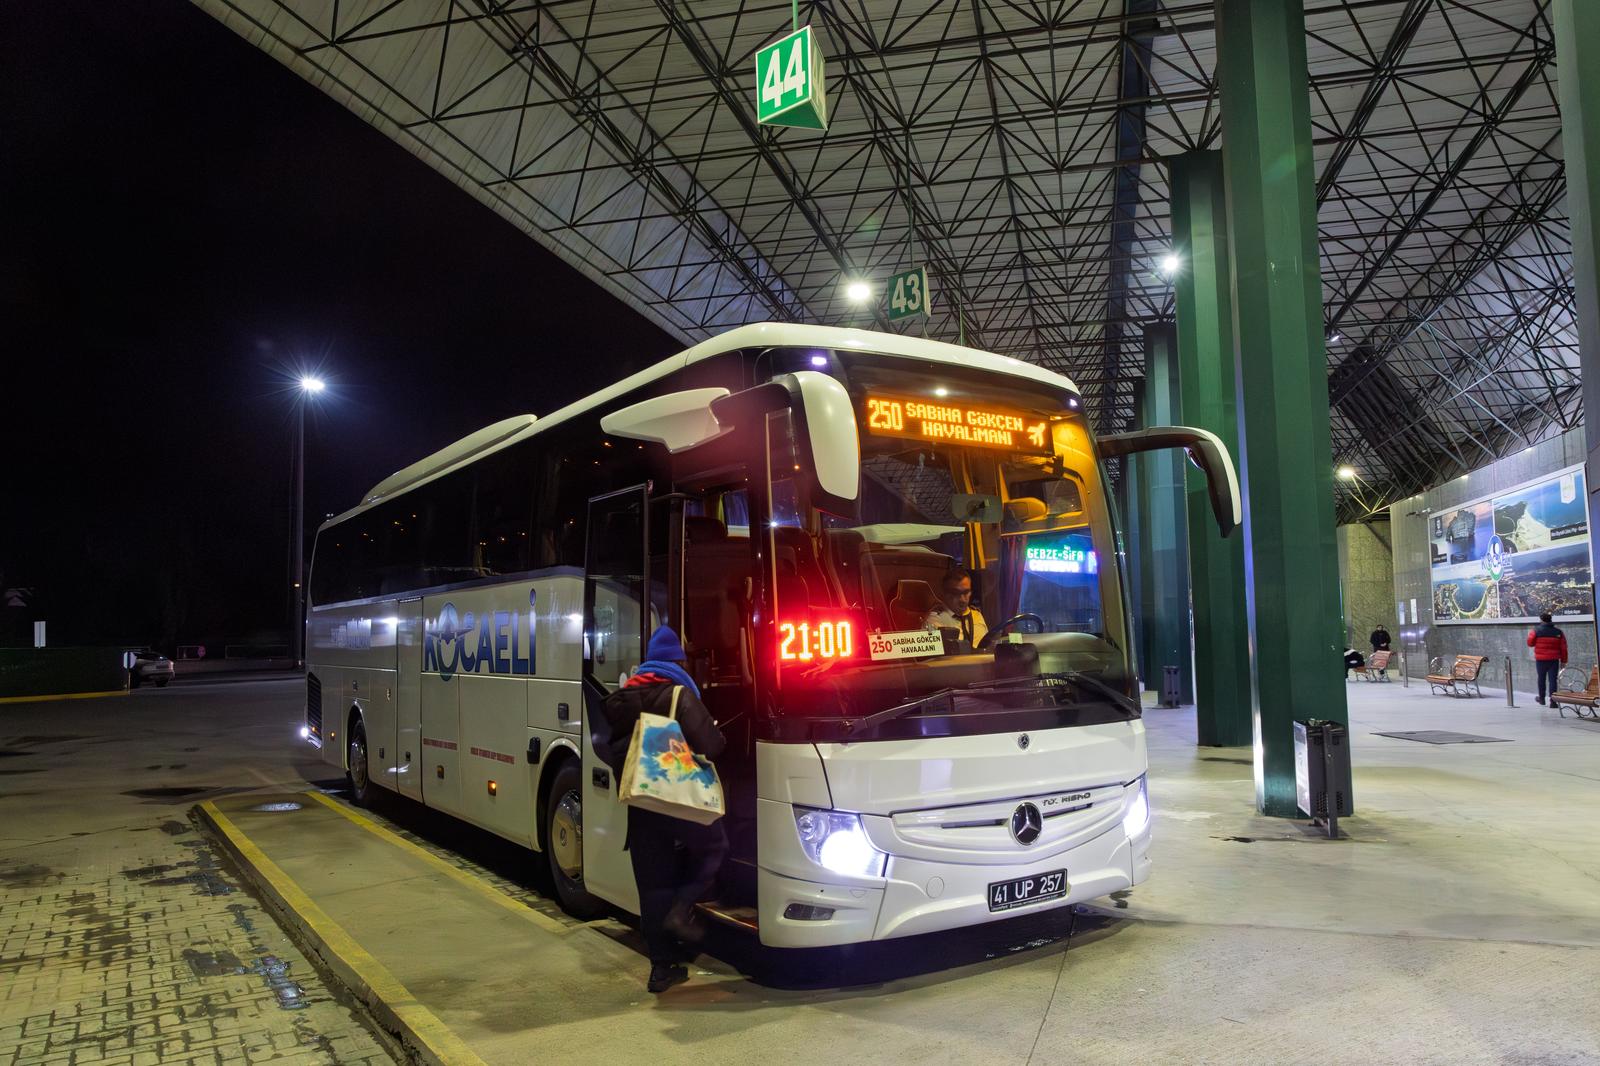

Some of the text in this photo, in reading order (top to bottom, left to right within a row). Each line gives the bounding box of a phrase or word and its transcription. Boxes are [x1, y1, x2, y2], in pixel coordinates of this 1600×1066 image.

[762, 37, 806, 108] 44
[892, 274, 921, 313] 43
[868, 399, 903, 431] 250
[780, 621, 852, 660] 21:00
[872, 635, 941, 654] 250 SABİHA GÖKÇEN
[901, 645, 936, 654] HAVAALANI
[994, 873, 1062, 903] 41 UP 257
